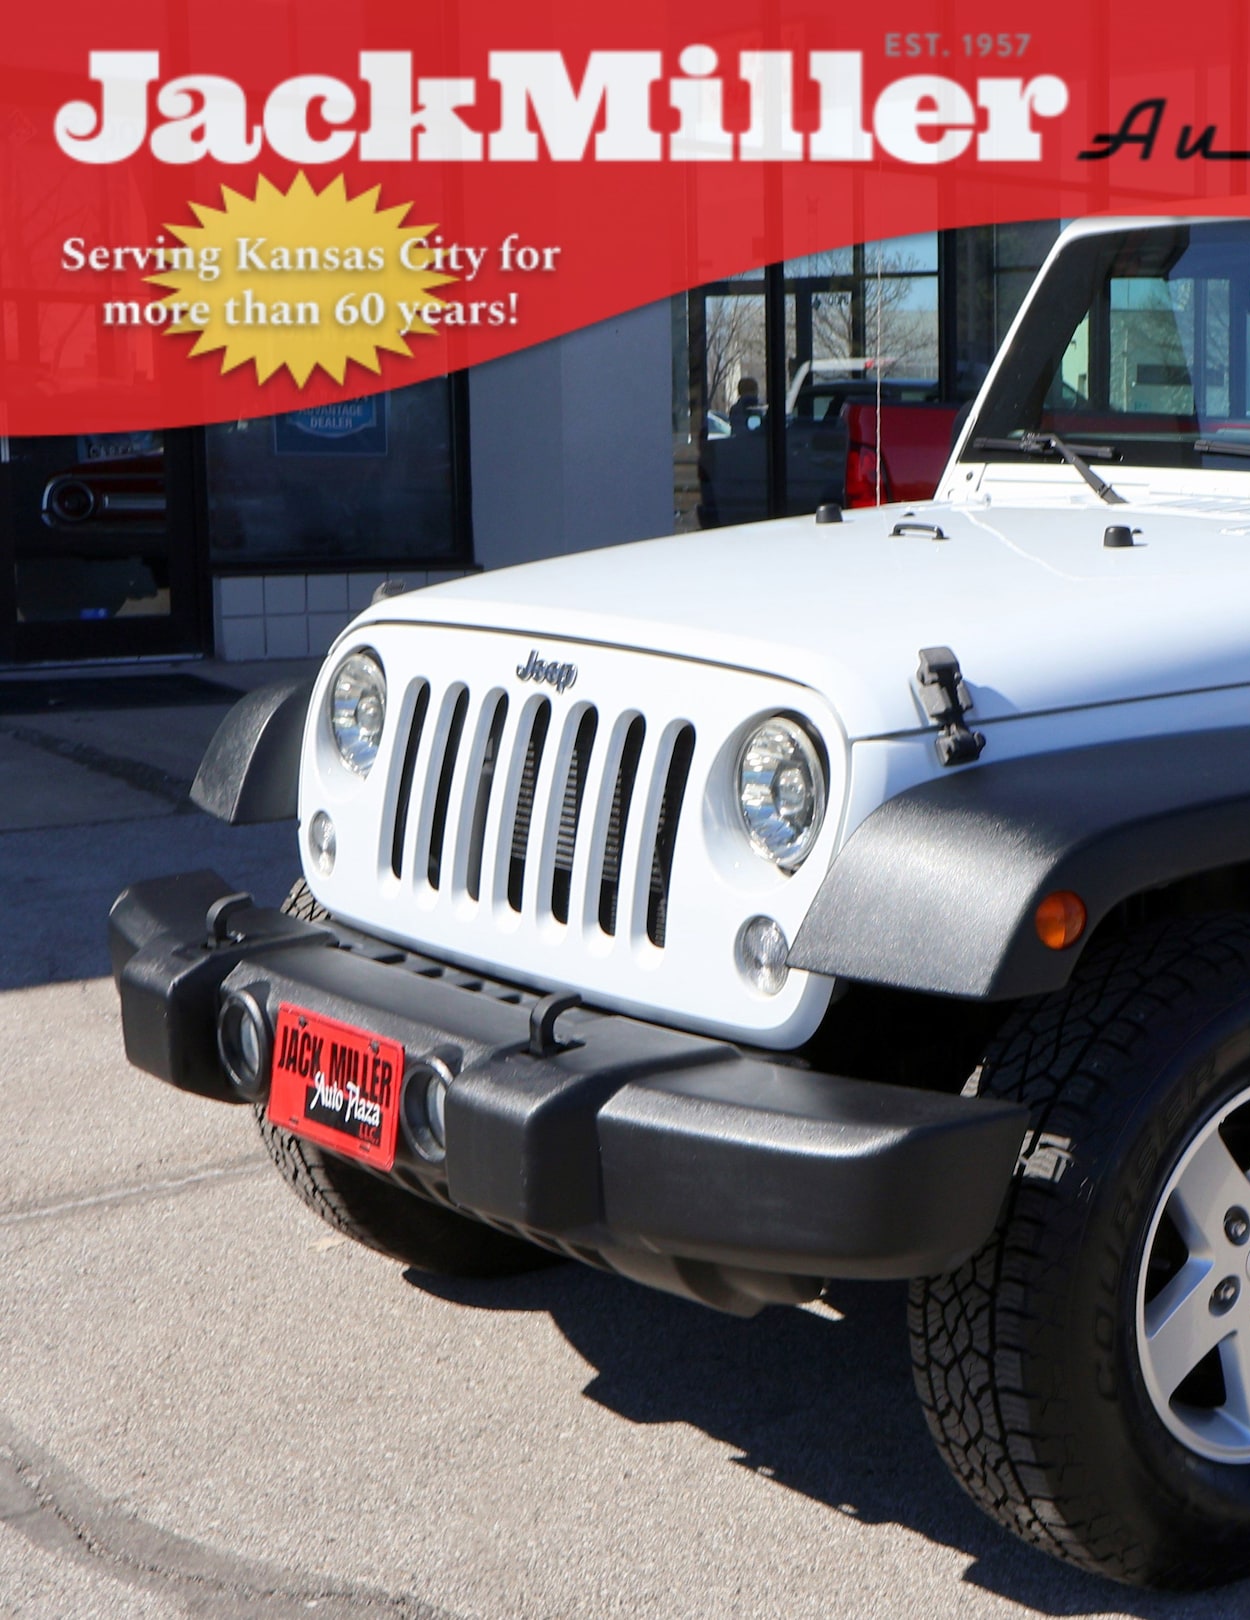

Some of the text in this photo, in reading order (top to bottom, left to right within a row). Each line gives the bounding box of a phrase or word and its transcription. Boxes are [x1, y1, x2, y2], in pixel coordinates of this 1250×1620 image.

[310, 416, 353, 429] DEALER
[516, 649, 578, 694] Jeep
[278, 1025, 393, 1109] JACK MILLER
[310, 1071, 381, 1127] Auto Plaza
